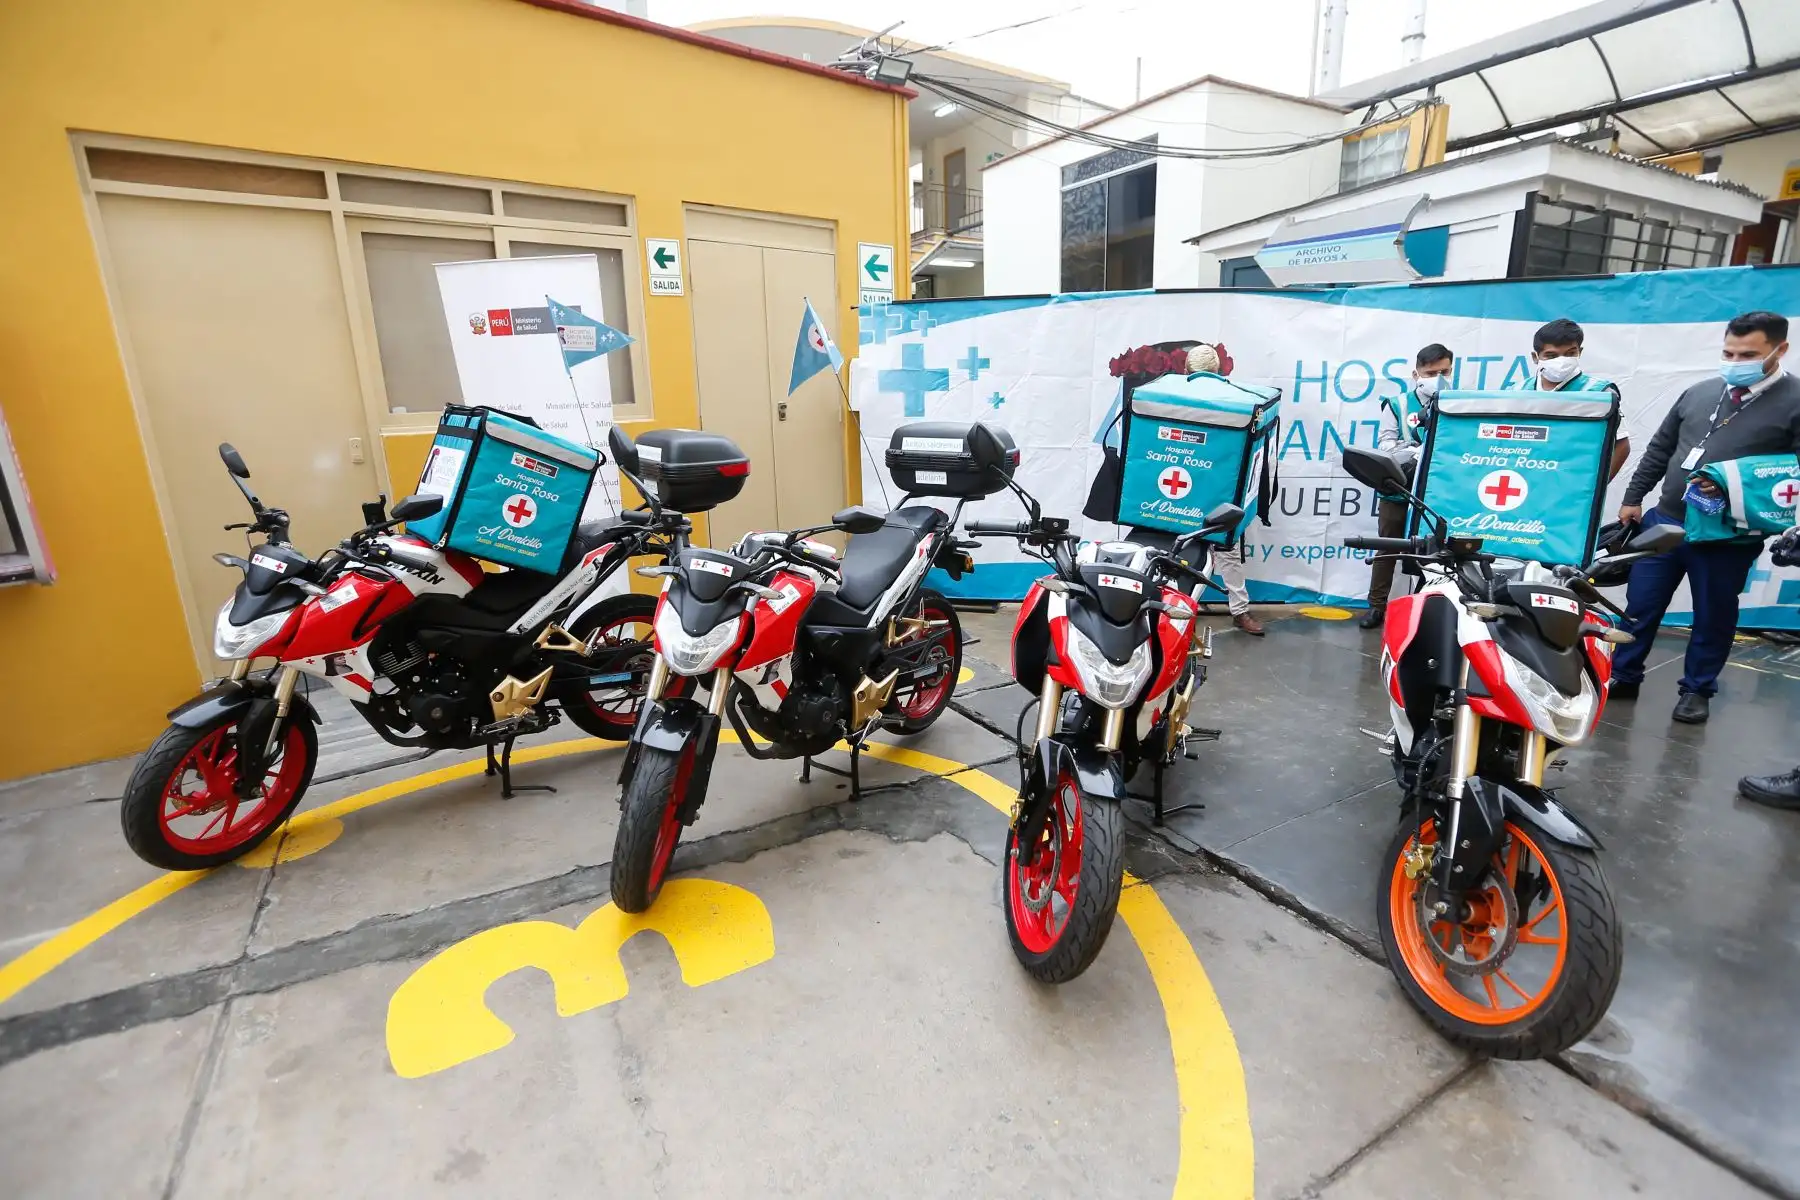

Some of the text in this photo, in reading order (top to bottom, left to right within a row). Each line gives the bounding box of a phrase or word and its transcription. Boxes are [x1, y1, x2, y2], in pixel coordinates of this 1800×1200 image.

[1296, 245, 1342, 257] ARCHIVO
[1303, 254, 1339, 265] RAYOS
[1340, 253, 1348, 261] X
[653, 280, 680, 291] SALIDA
[491, 317, 509, 327] PERÚ
[590, 401, 612, 409] Salud
[1165, 445, 1195, 456] Hospital
[1488, 445, 1532, 455] Hospital
[1146, 450, 1213, 469] Santa Rosa
[1460, 452, 1559, 470] Santa Rosa
[516, 472, 545, 487] Hospital
[494, 473, 560, 502] Santa Rosa
[1141, 499, 1204, 518] A Domicilio
[1450, 512, 1546, 533] A Domicilio
[478, 525, 543, 549] A Domicilio
[1260, 544, 1274, 563] y
